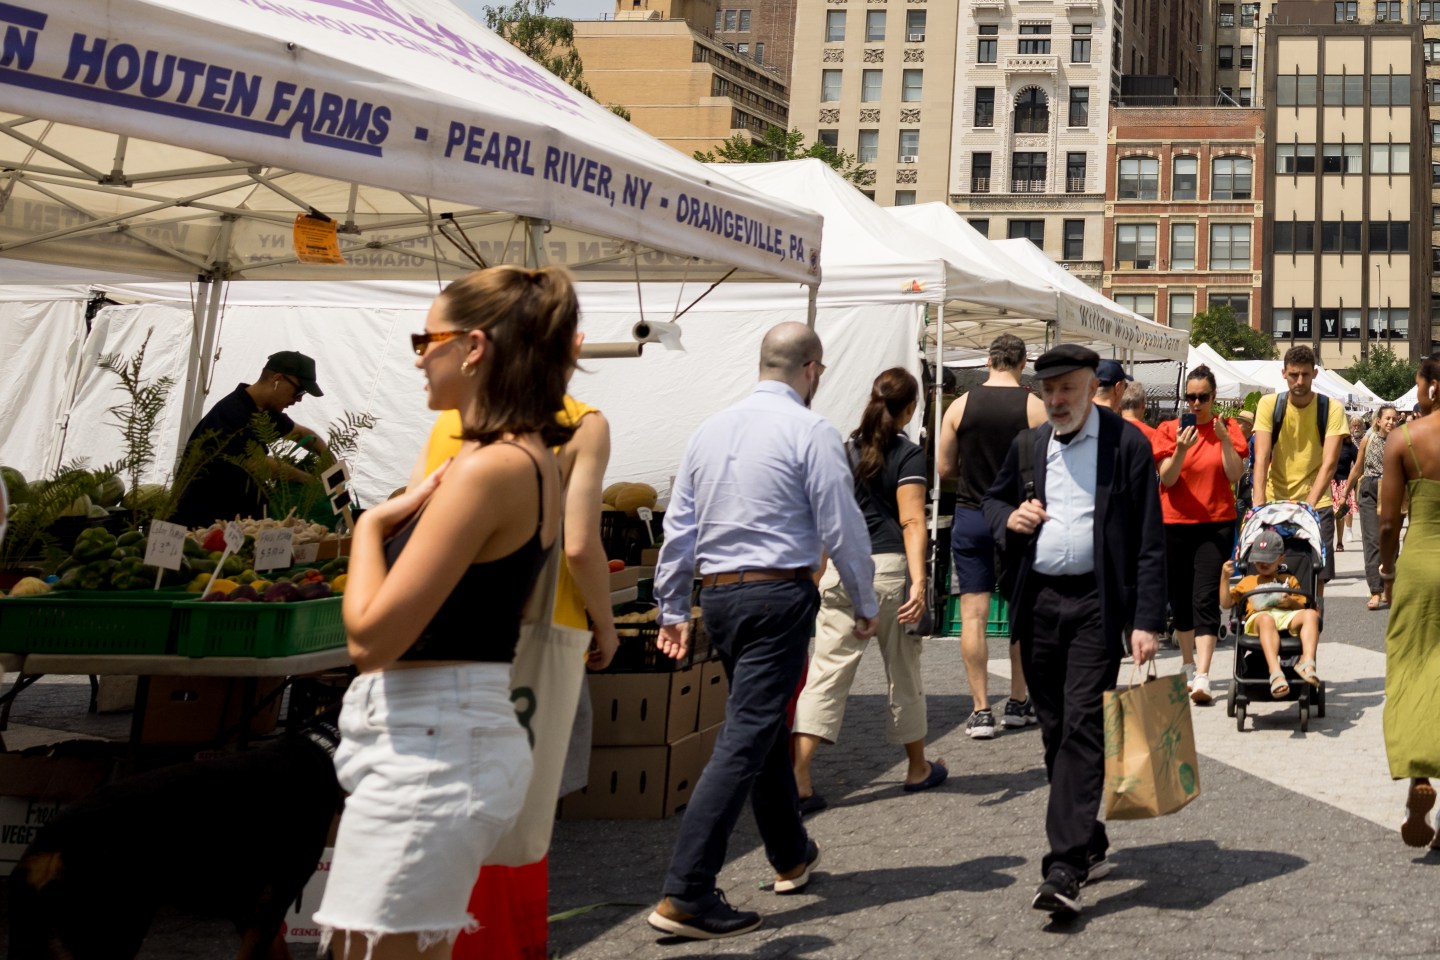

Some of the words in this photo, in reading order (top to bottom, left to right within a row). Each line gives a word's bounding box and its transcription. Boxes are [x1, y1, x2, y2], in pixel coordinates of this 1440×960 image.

[62, 32, 262, 118] HOUTEN
[266, 81, 392, 145] FARMS
[444, 121, 535, 176] PEARL
[542, 145, 616, 208] RIVER,
[622, 172, 653, 210] NY
[676, 193, 787, 262] ORANGEVILLE,
[789, 234, 806, 263] PA
[1080, 304, 1113, 335] Willow
[1112, 317, 1135, 346] Wisp
[1134, 325, 1164, 351] Organic
